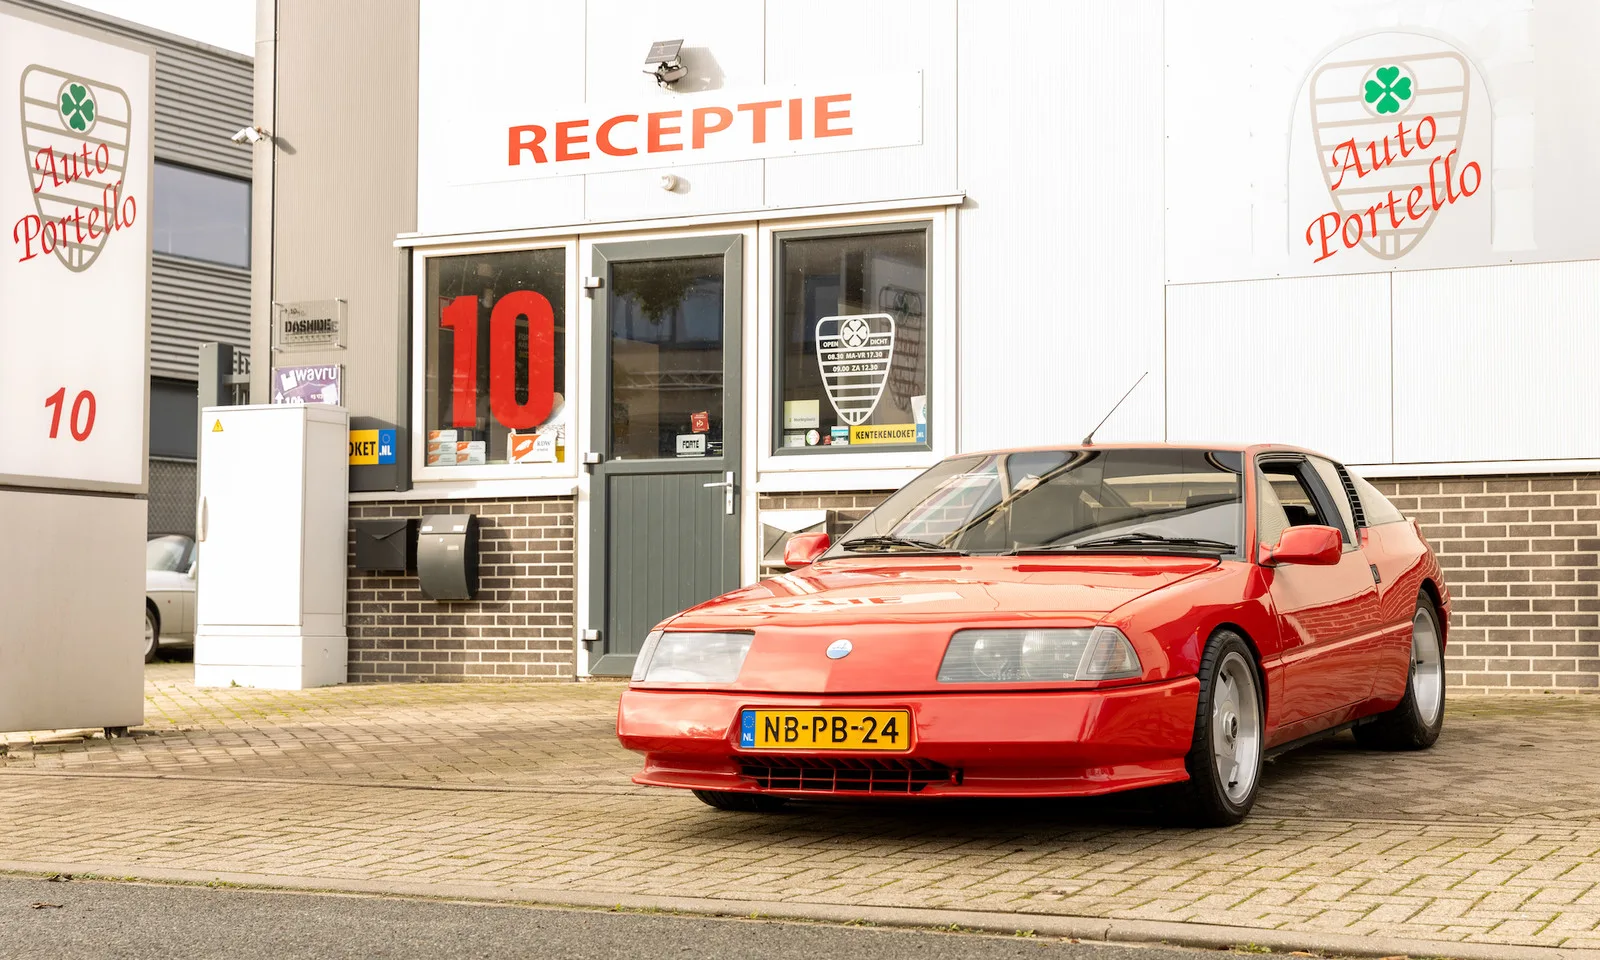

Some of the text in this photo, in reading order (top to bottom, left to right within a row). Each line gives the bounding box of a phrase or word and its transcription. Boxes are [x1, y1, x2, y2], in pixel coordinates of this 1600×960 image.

[508, 93, 853, 167] RECEPTIE
[1331, 115, 1437, 191] Auto
[34, 142, 109, 193] Auto
[13, 180, 136, 263] Portello
[1305, 148, 1482, 263] Portello
[296, 367, 337, 381] wavru
[442, 290, 555, 429] 10
[832, 365, 850, 373] 09.00
[45, 387, 96, 441] 10
[855, 429, 915, 440] KENTEKENLOKET
[379, 445, 392, 456] .NL
[742, 733, 754, 742] NL
[764, 716, 899, 744] NB-PB-24
